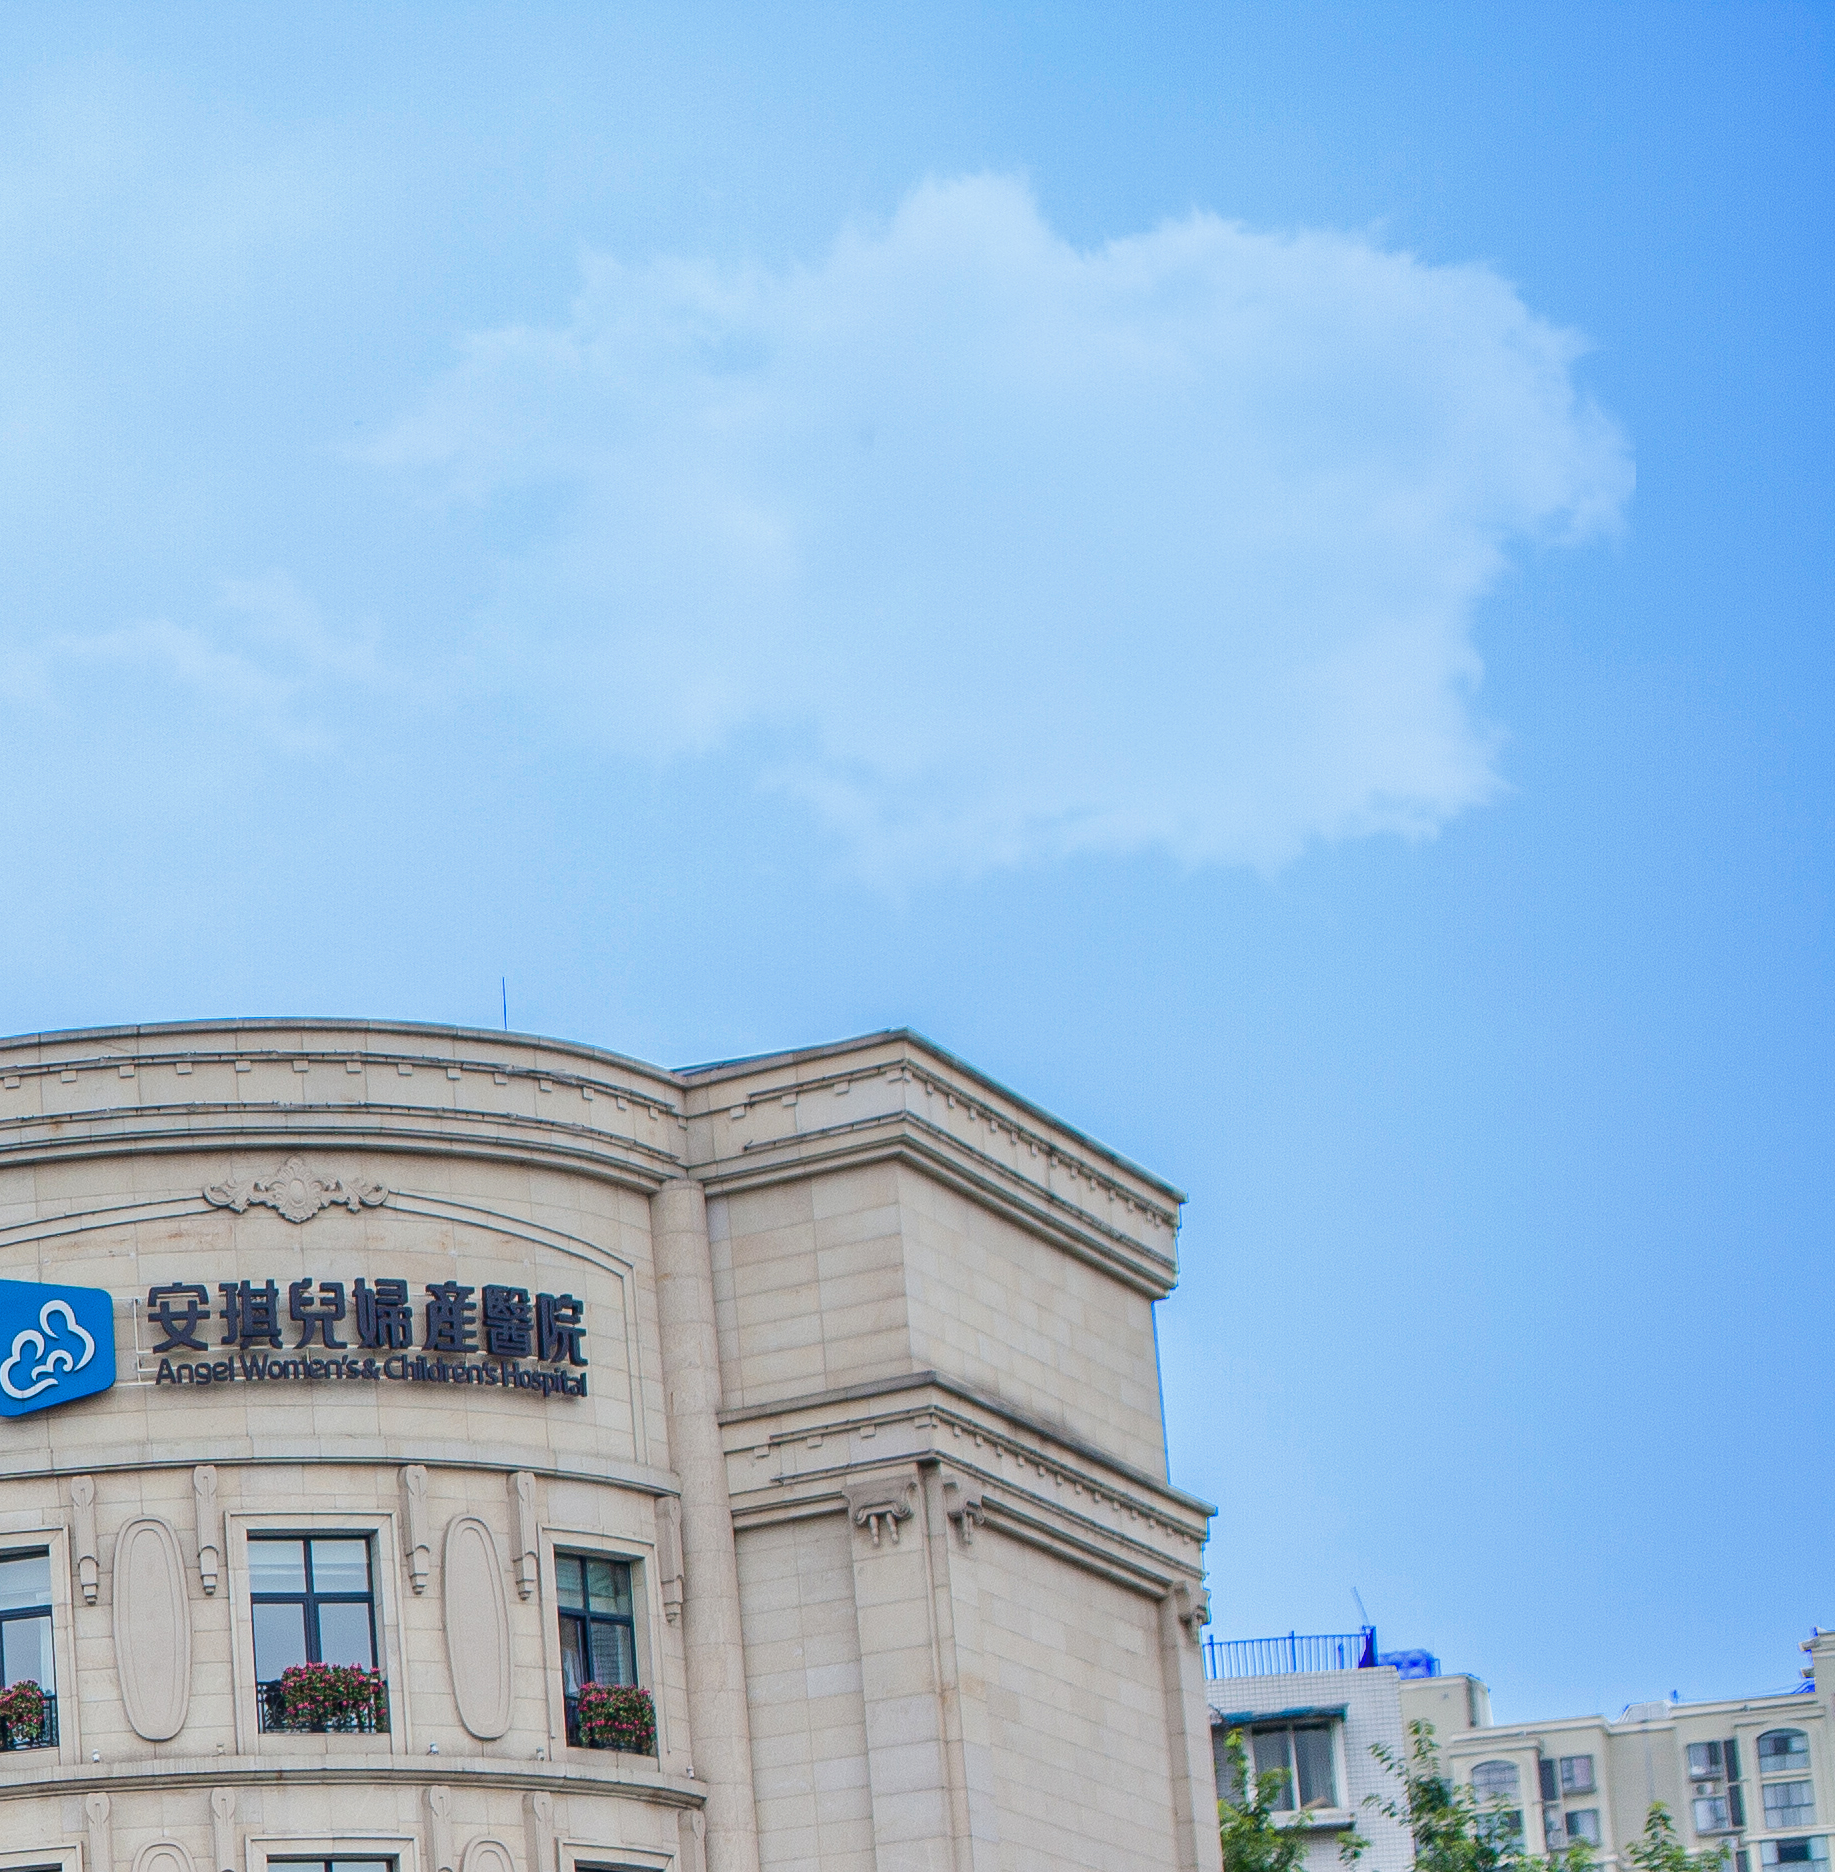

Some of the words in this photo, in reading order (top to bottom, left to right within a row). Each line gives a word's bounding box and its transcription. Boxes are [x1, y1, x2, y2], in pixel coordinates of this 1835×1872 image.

[155, 1358, 235, 1385] Angel
[238, 1353, 359, 1381] Women's
[384, 1354, 499, 1385] Children's
[501, 1360, 588, 1397] Hospital
